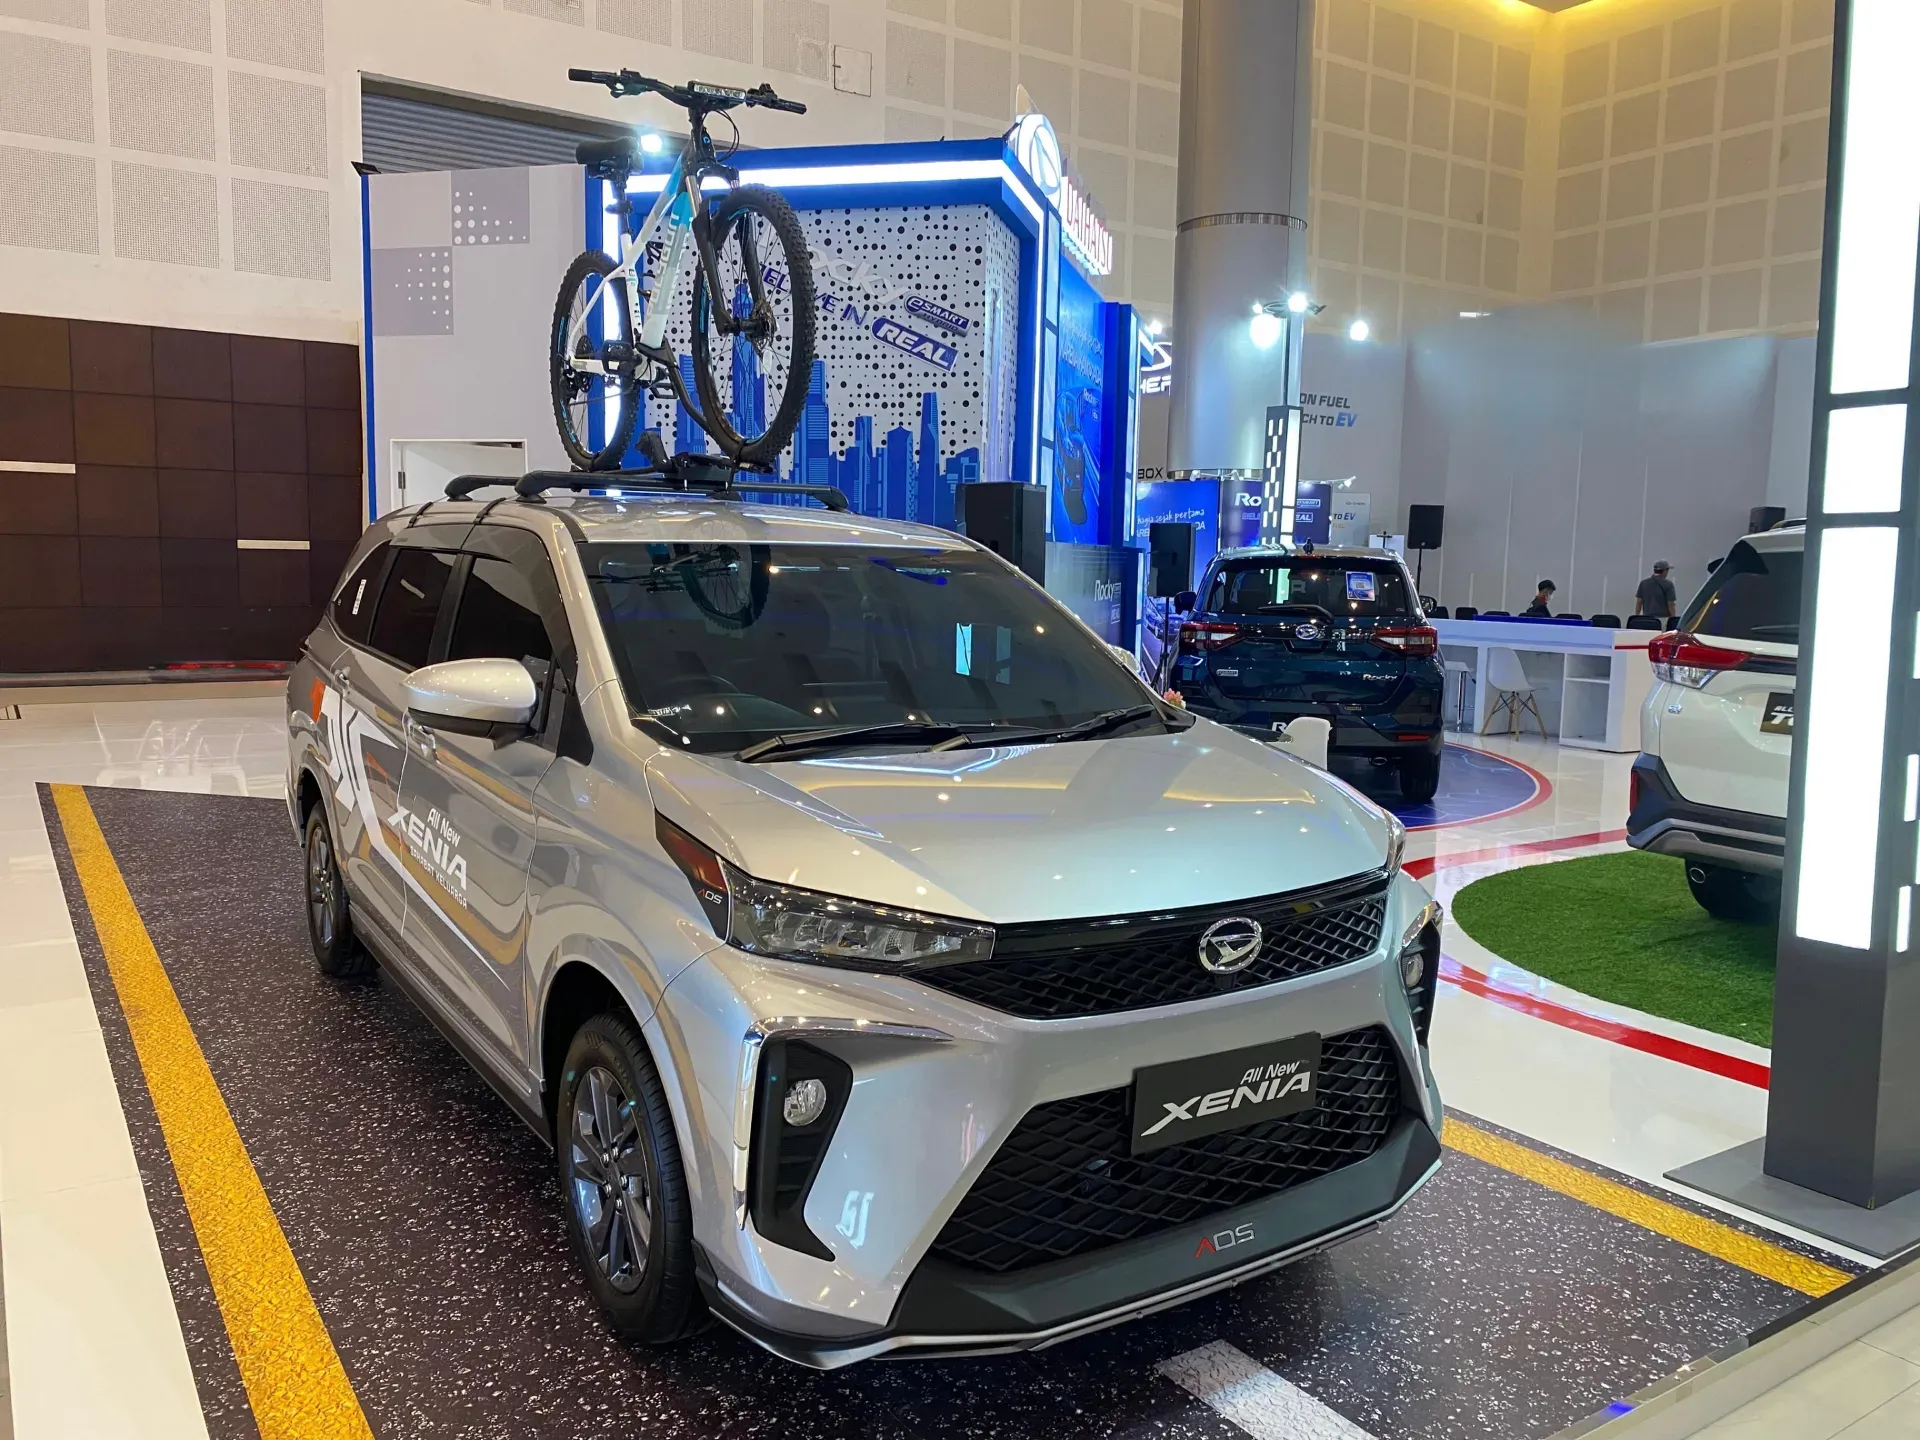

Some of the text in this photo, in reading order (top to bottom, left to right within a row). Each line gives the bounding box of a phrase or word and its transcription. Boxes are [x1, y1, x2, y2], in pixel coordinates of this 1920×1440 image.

[922, 312, 959, 332] HYBRID
[841, 304, 868, 326] IN
[876, 323, 950, 367] REAL
[1319, 395, 1351, 409] FUEL
[1320, 415, 1334, 426] TO
[1336, 411, 1358, 427] EV
[1156, 510, 1173, 523] sejak
[1175, 508, 1205, 523] pertama
[1343, 512, 1356, 520] EV
[427, 808, 460, 848] All New
[387, 805, 467, 891] XENIA
[435, 870, 467, 910] KELUARGA
[1240, 1061, 1301, 1086] All New
[1140, 1071, 1311, 1137] XENIA
